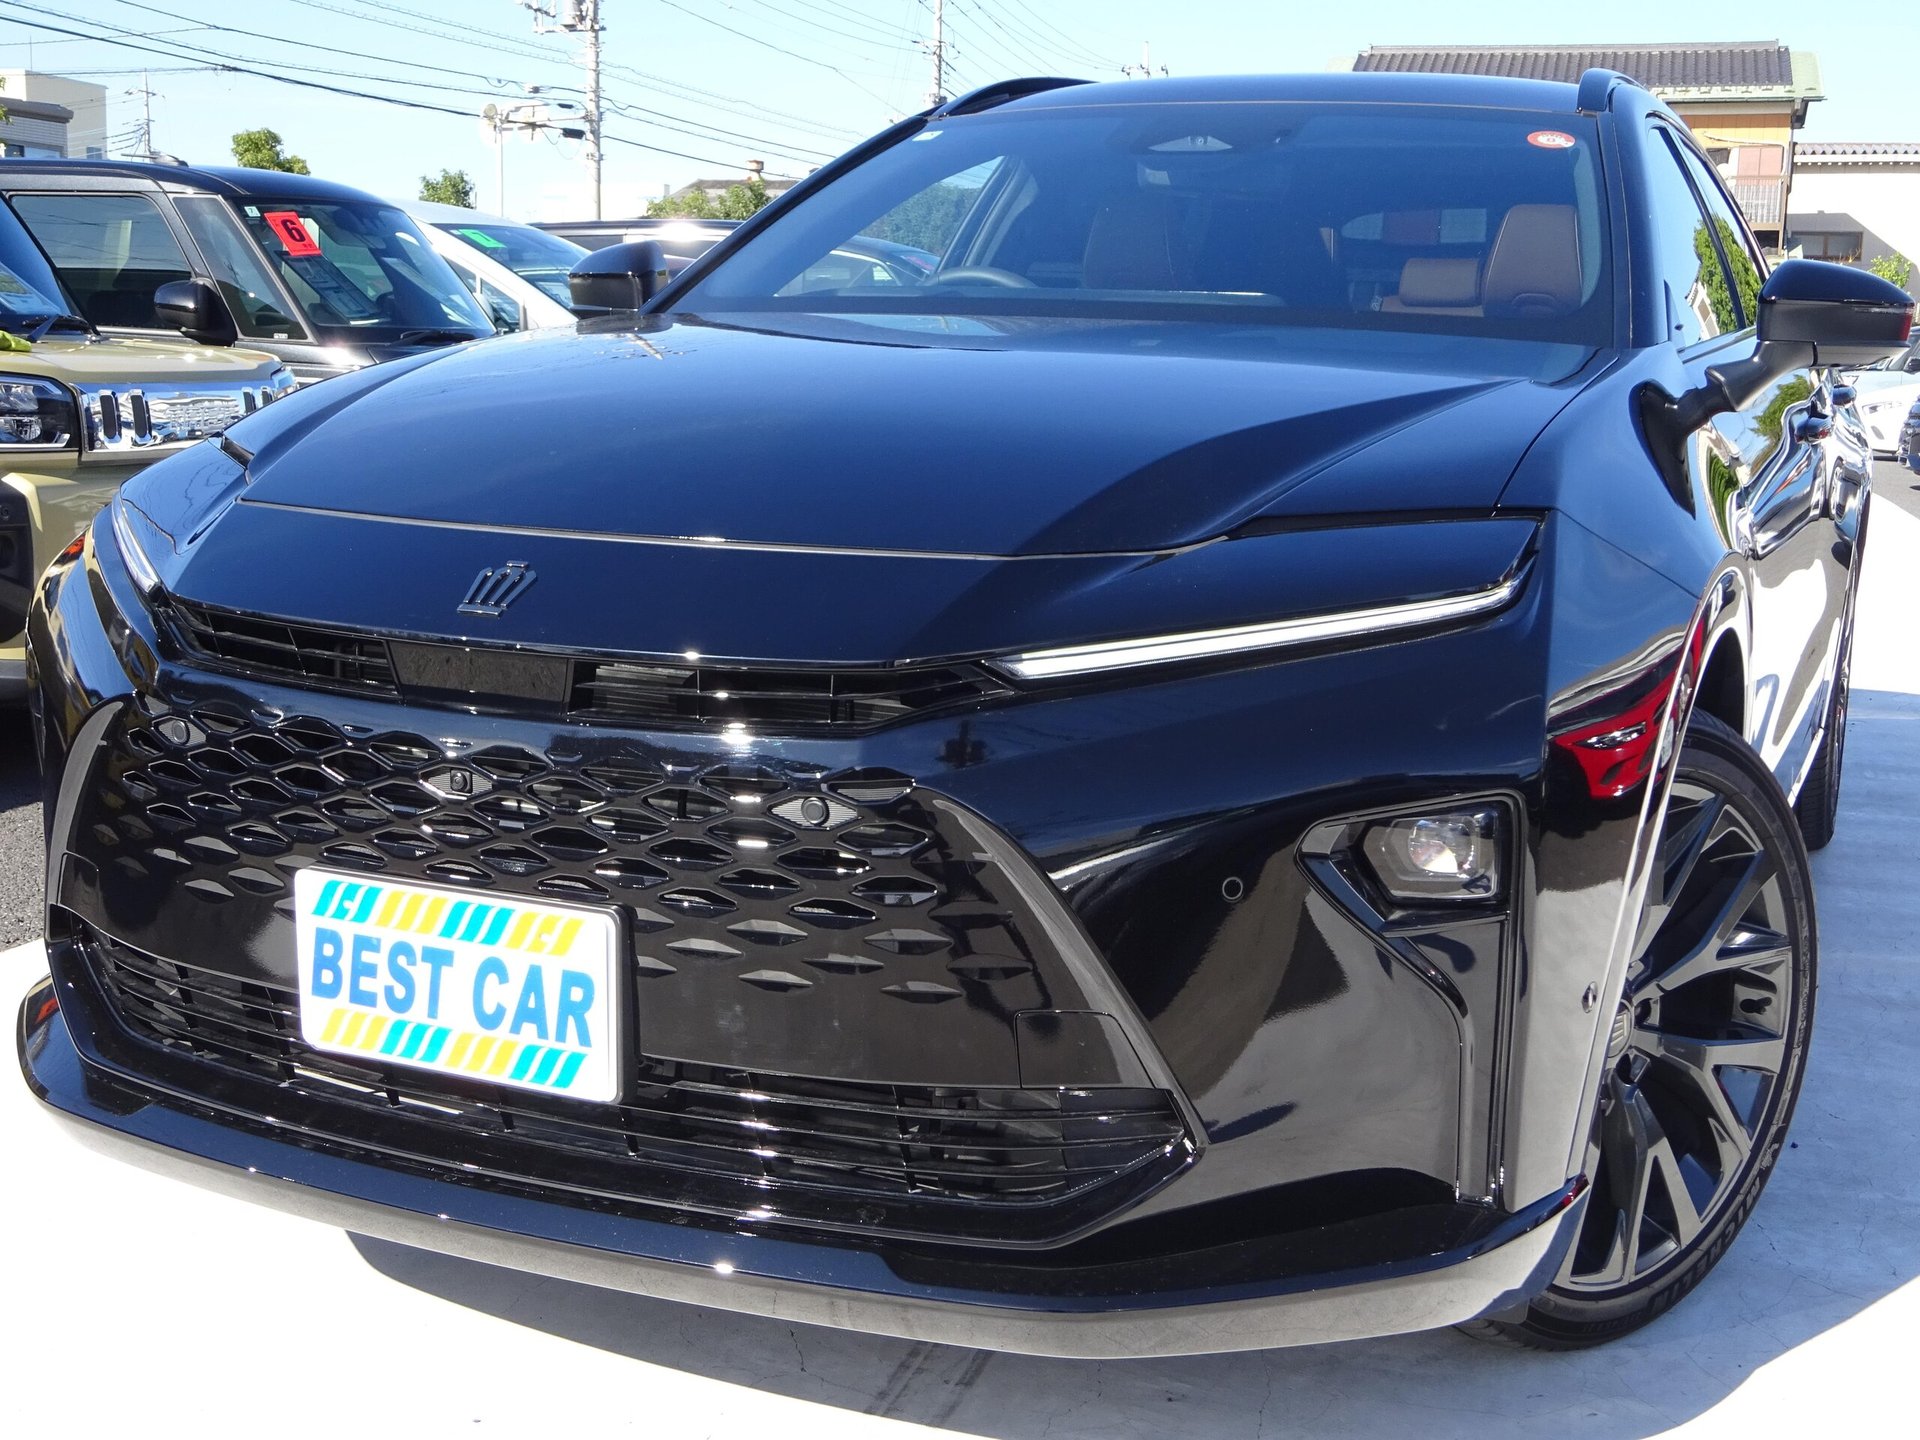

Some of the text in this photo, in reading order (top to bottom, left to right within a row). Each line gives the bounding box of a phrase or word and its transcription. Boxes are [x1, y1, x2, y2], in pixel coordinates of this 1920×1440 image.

[281, 219, 306, 243] 6
[311, 926, 596, 1048] BEST CAR
[1652, 1176, 1761, 1311] MICHELIN
